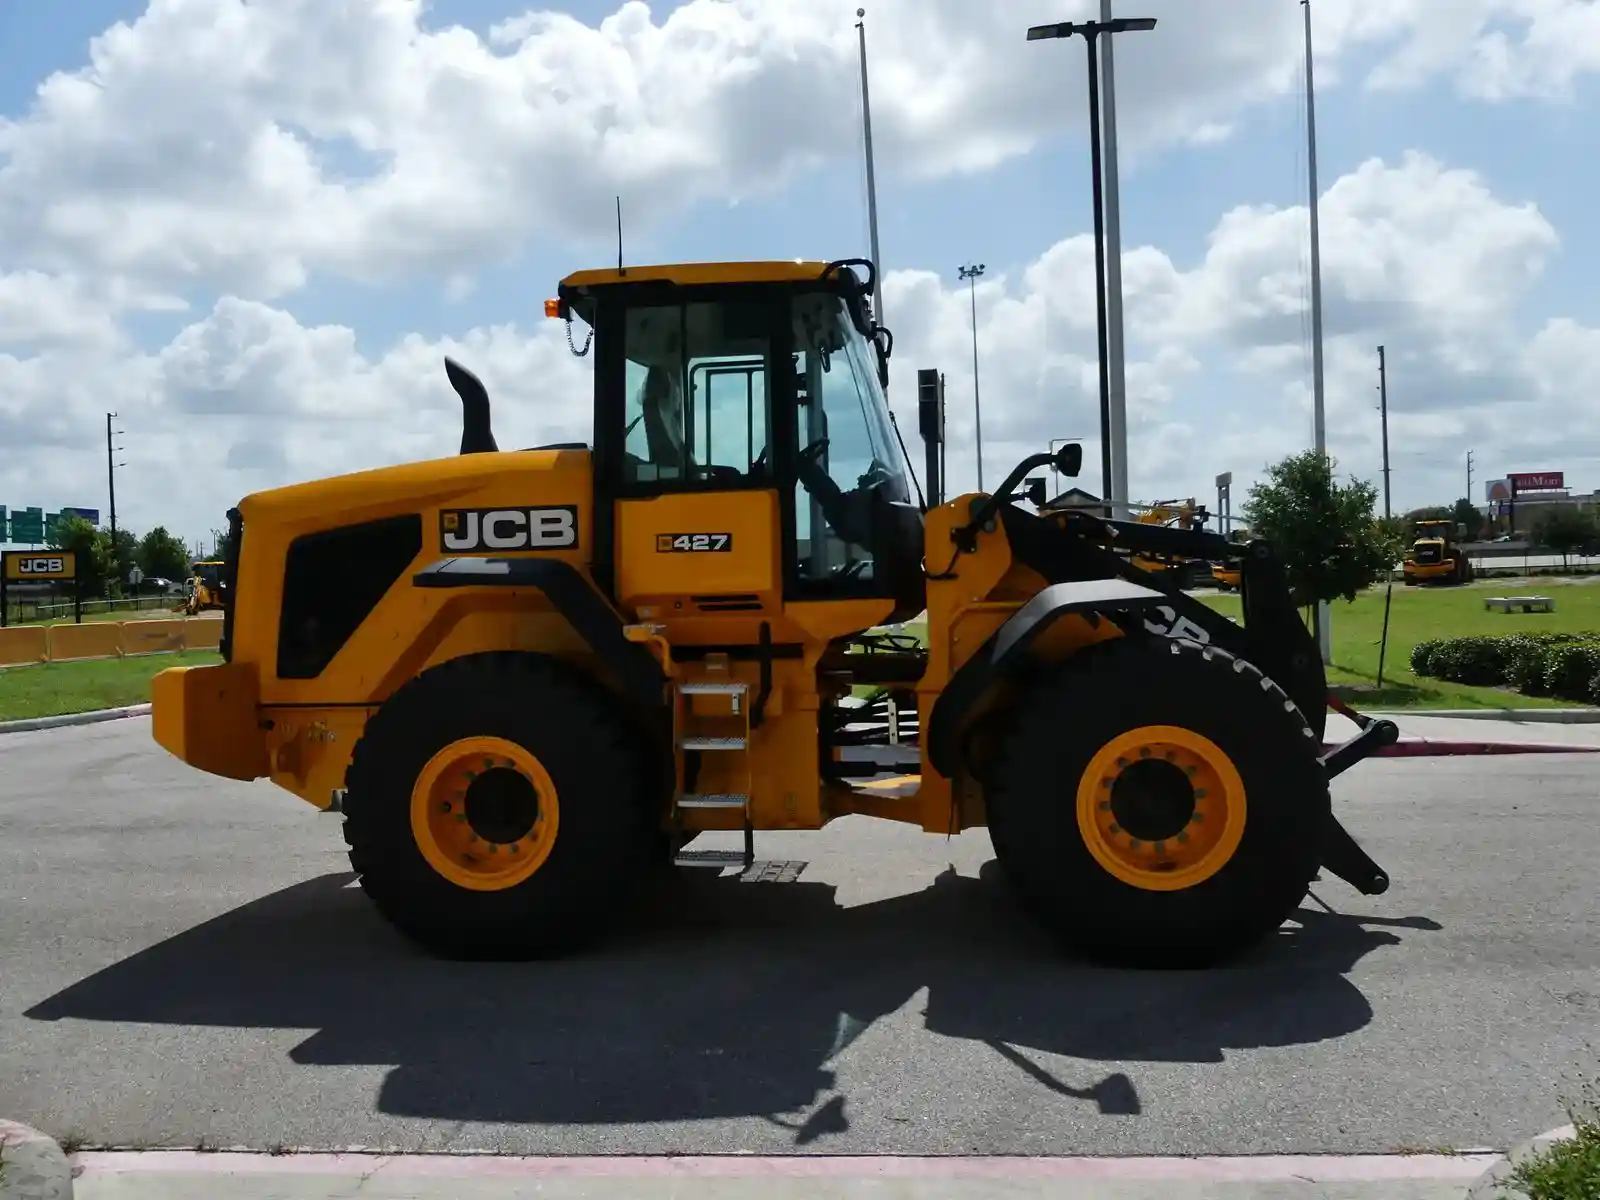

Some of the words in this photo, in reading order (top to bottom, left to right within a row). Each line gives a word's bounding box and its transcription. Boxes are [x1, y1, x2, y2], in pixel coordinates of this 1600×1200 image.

[443, 508, 576, 550] JCB
[673, 534, 729, 551] 427
[19, 558, 63, 572] JCB
